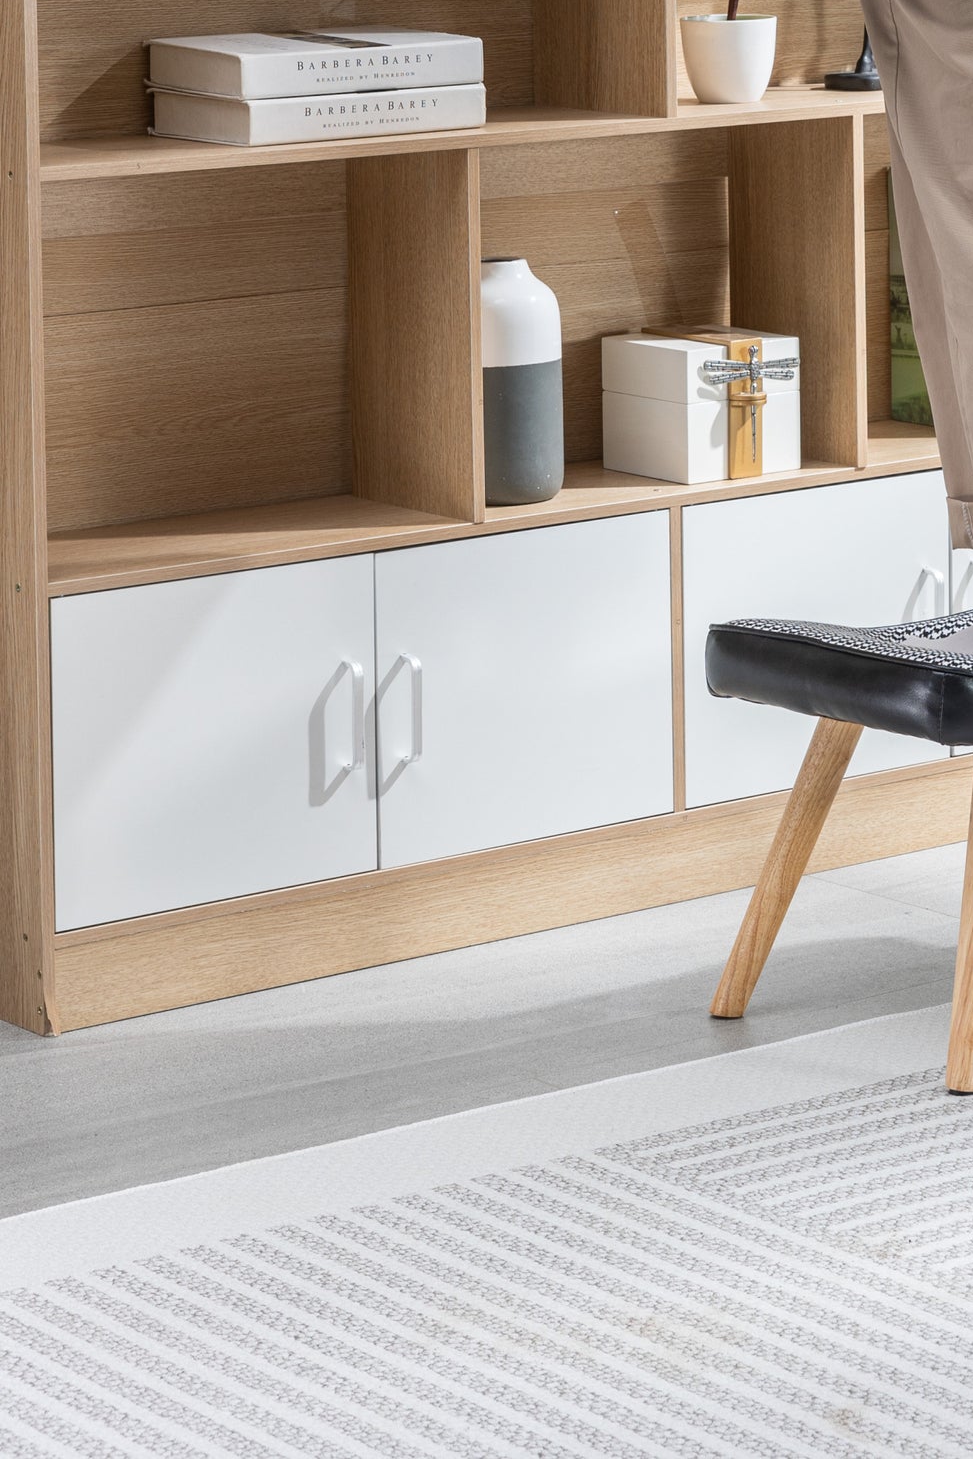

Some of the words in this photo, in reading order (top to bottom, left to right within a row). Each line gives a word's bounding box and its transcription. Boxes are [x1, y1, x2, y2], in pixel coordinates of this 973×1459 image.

[297, 57, 374, 71] BARBERA
[382, 53, 433, 66] BAREY
[304, 103, 381, 117] BARBERA
[388, 98, 438, 111] BAREY
